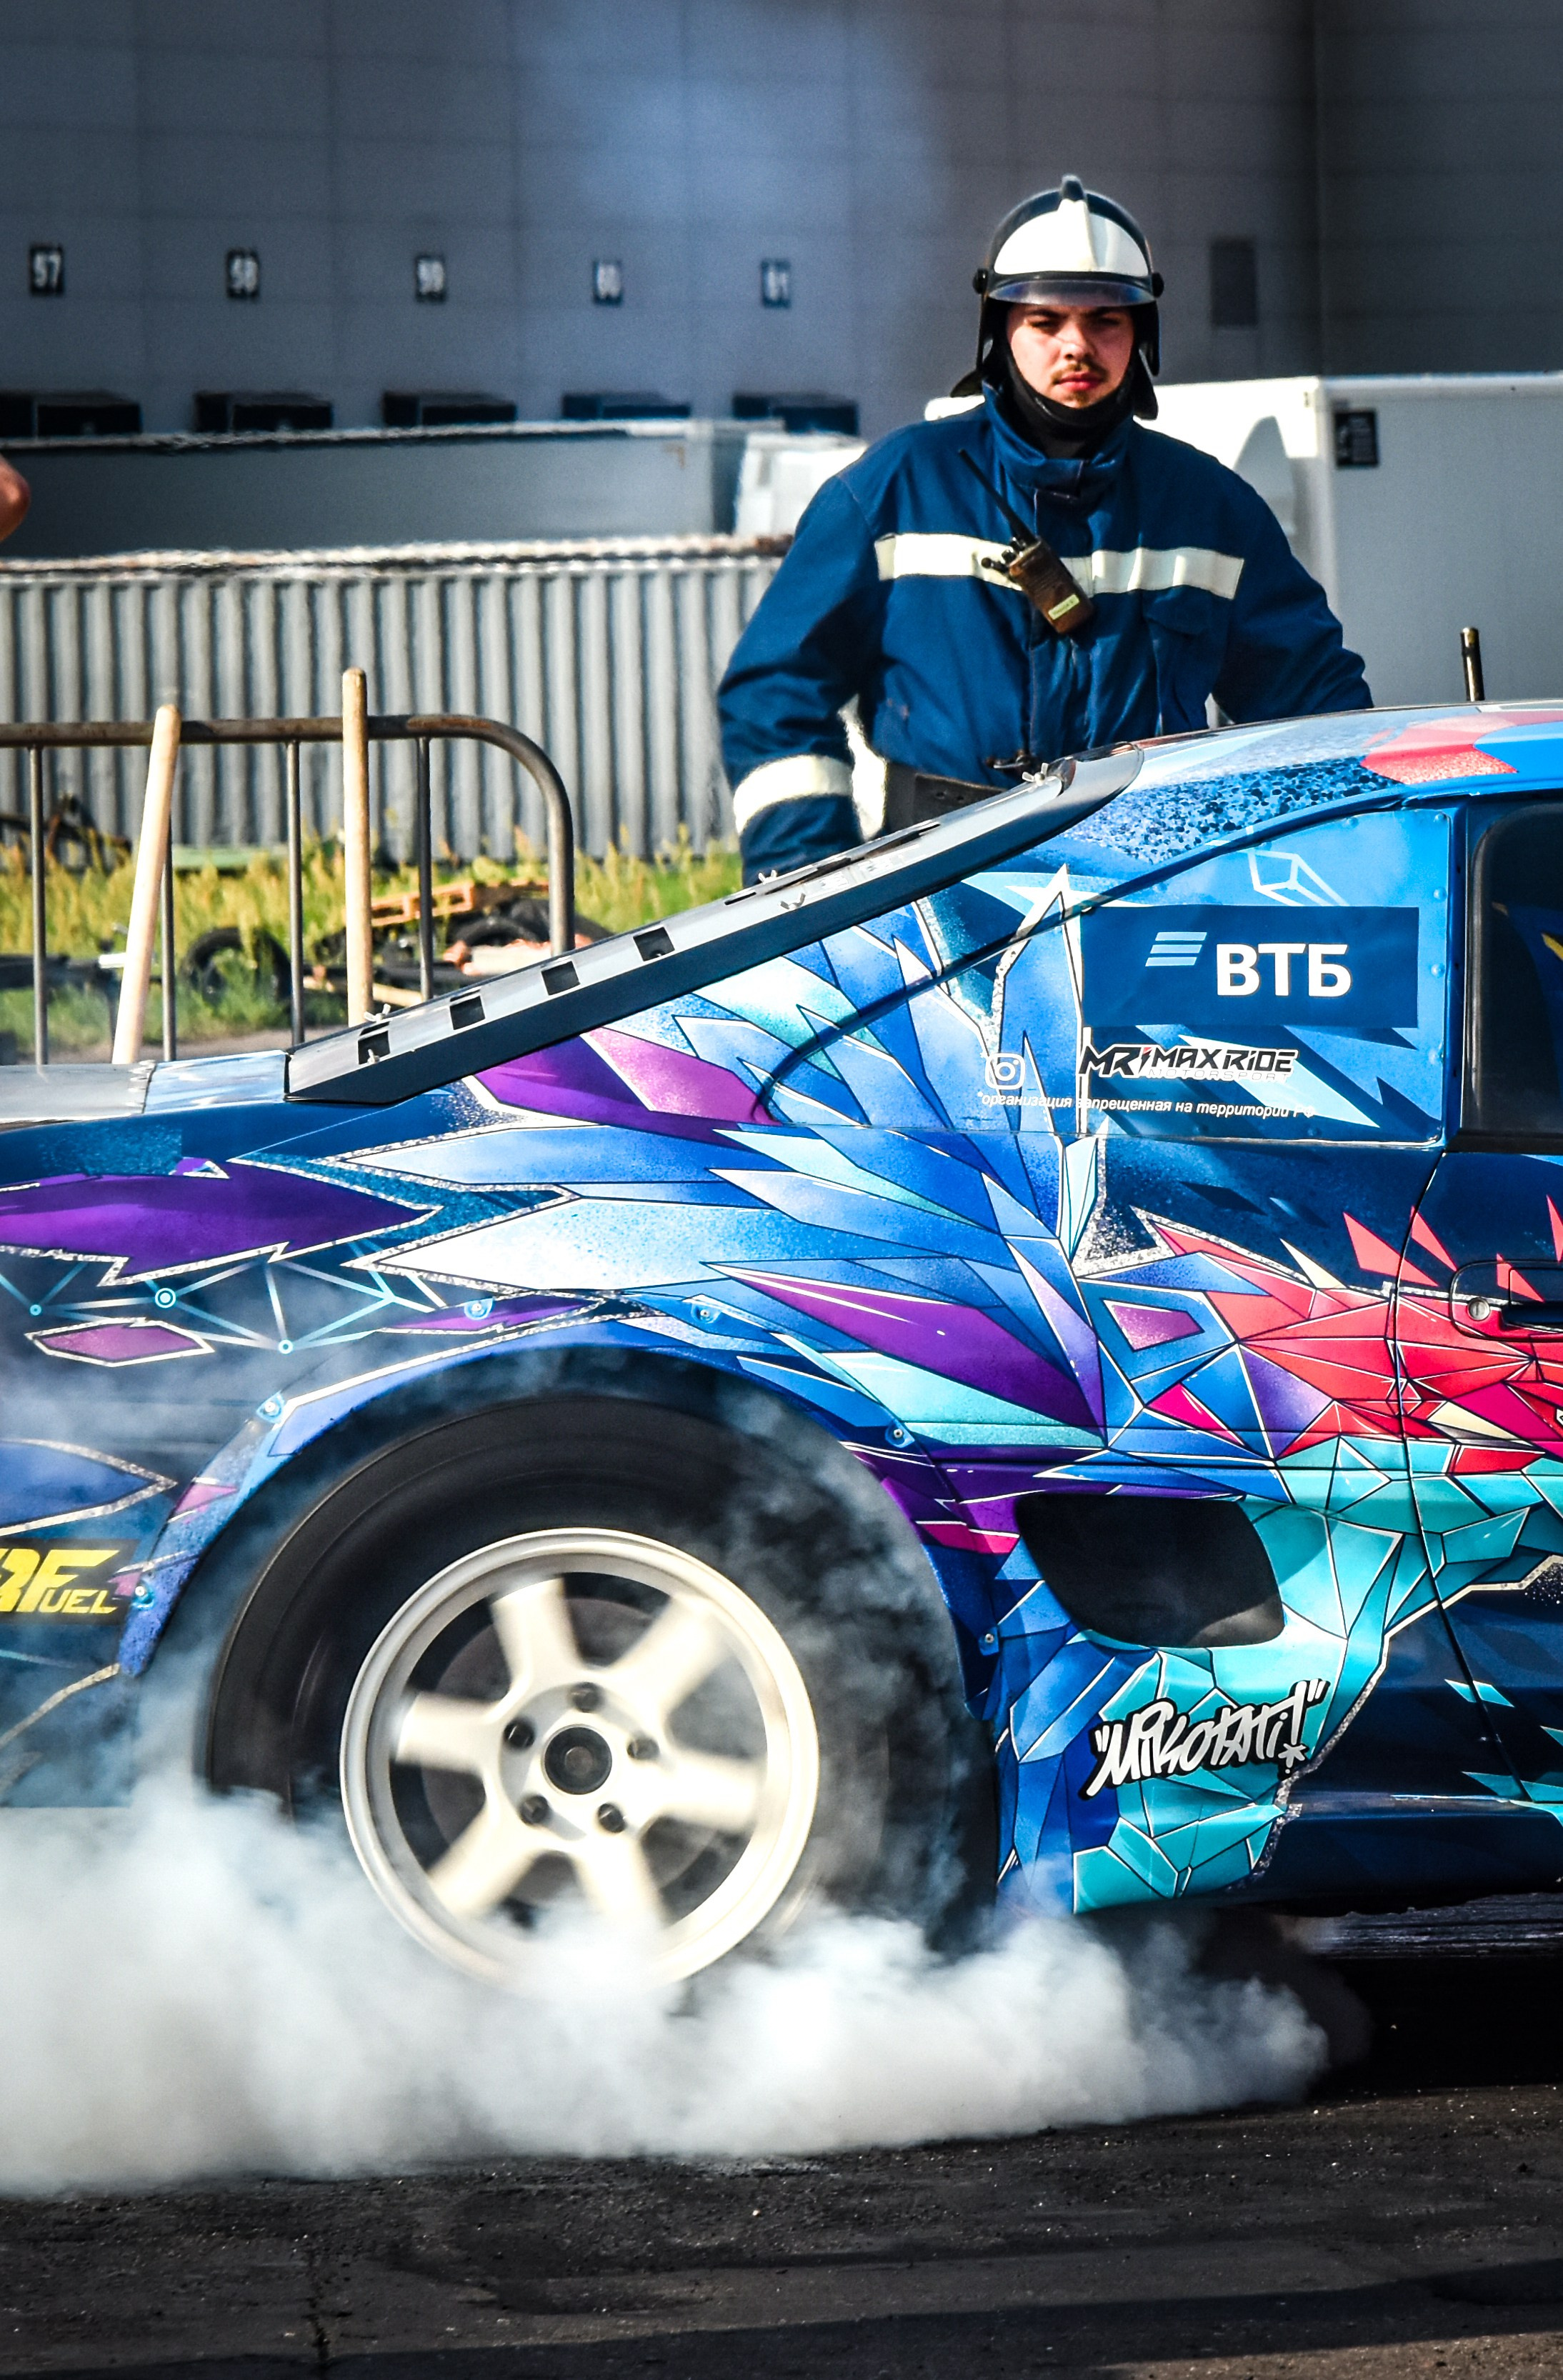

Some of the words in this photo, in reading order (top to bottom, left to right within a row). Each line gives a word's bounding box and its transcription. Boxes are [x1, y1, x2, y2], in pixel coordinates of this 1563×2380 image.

[1217, 944, 1352, 997] ВТБ
[1175, 1101, 1192, 1113] на
[1197, 1103, 1289, 1119] территории
